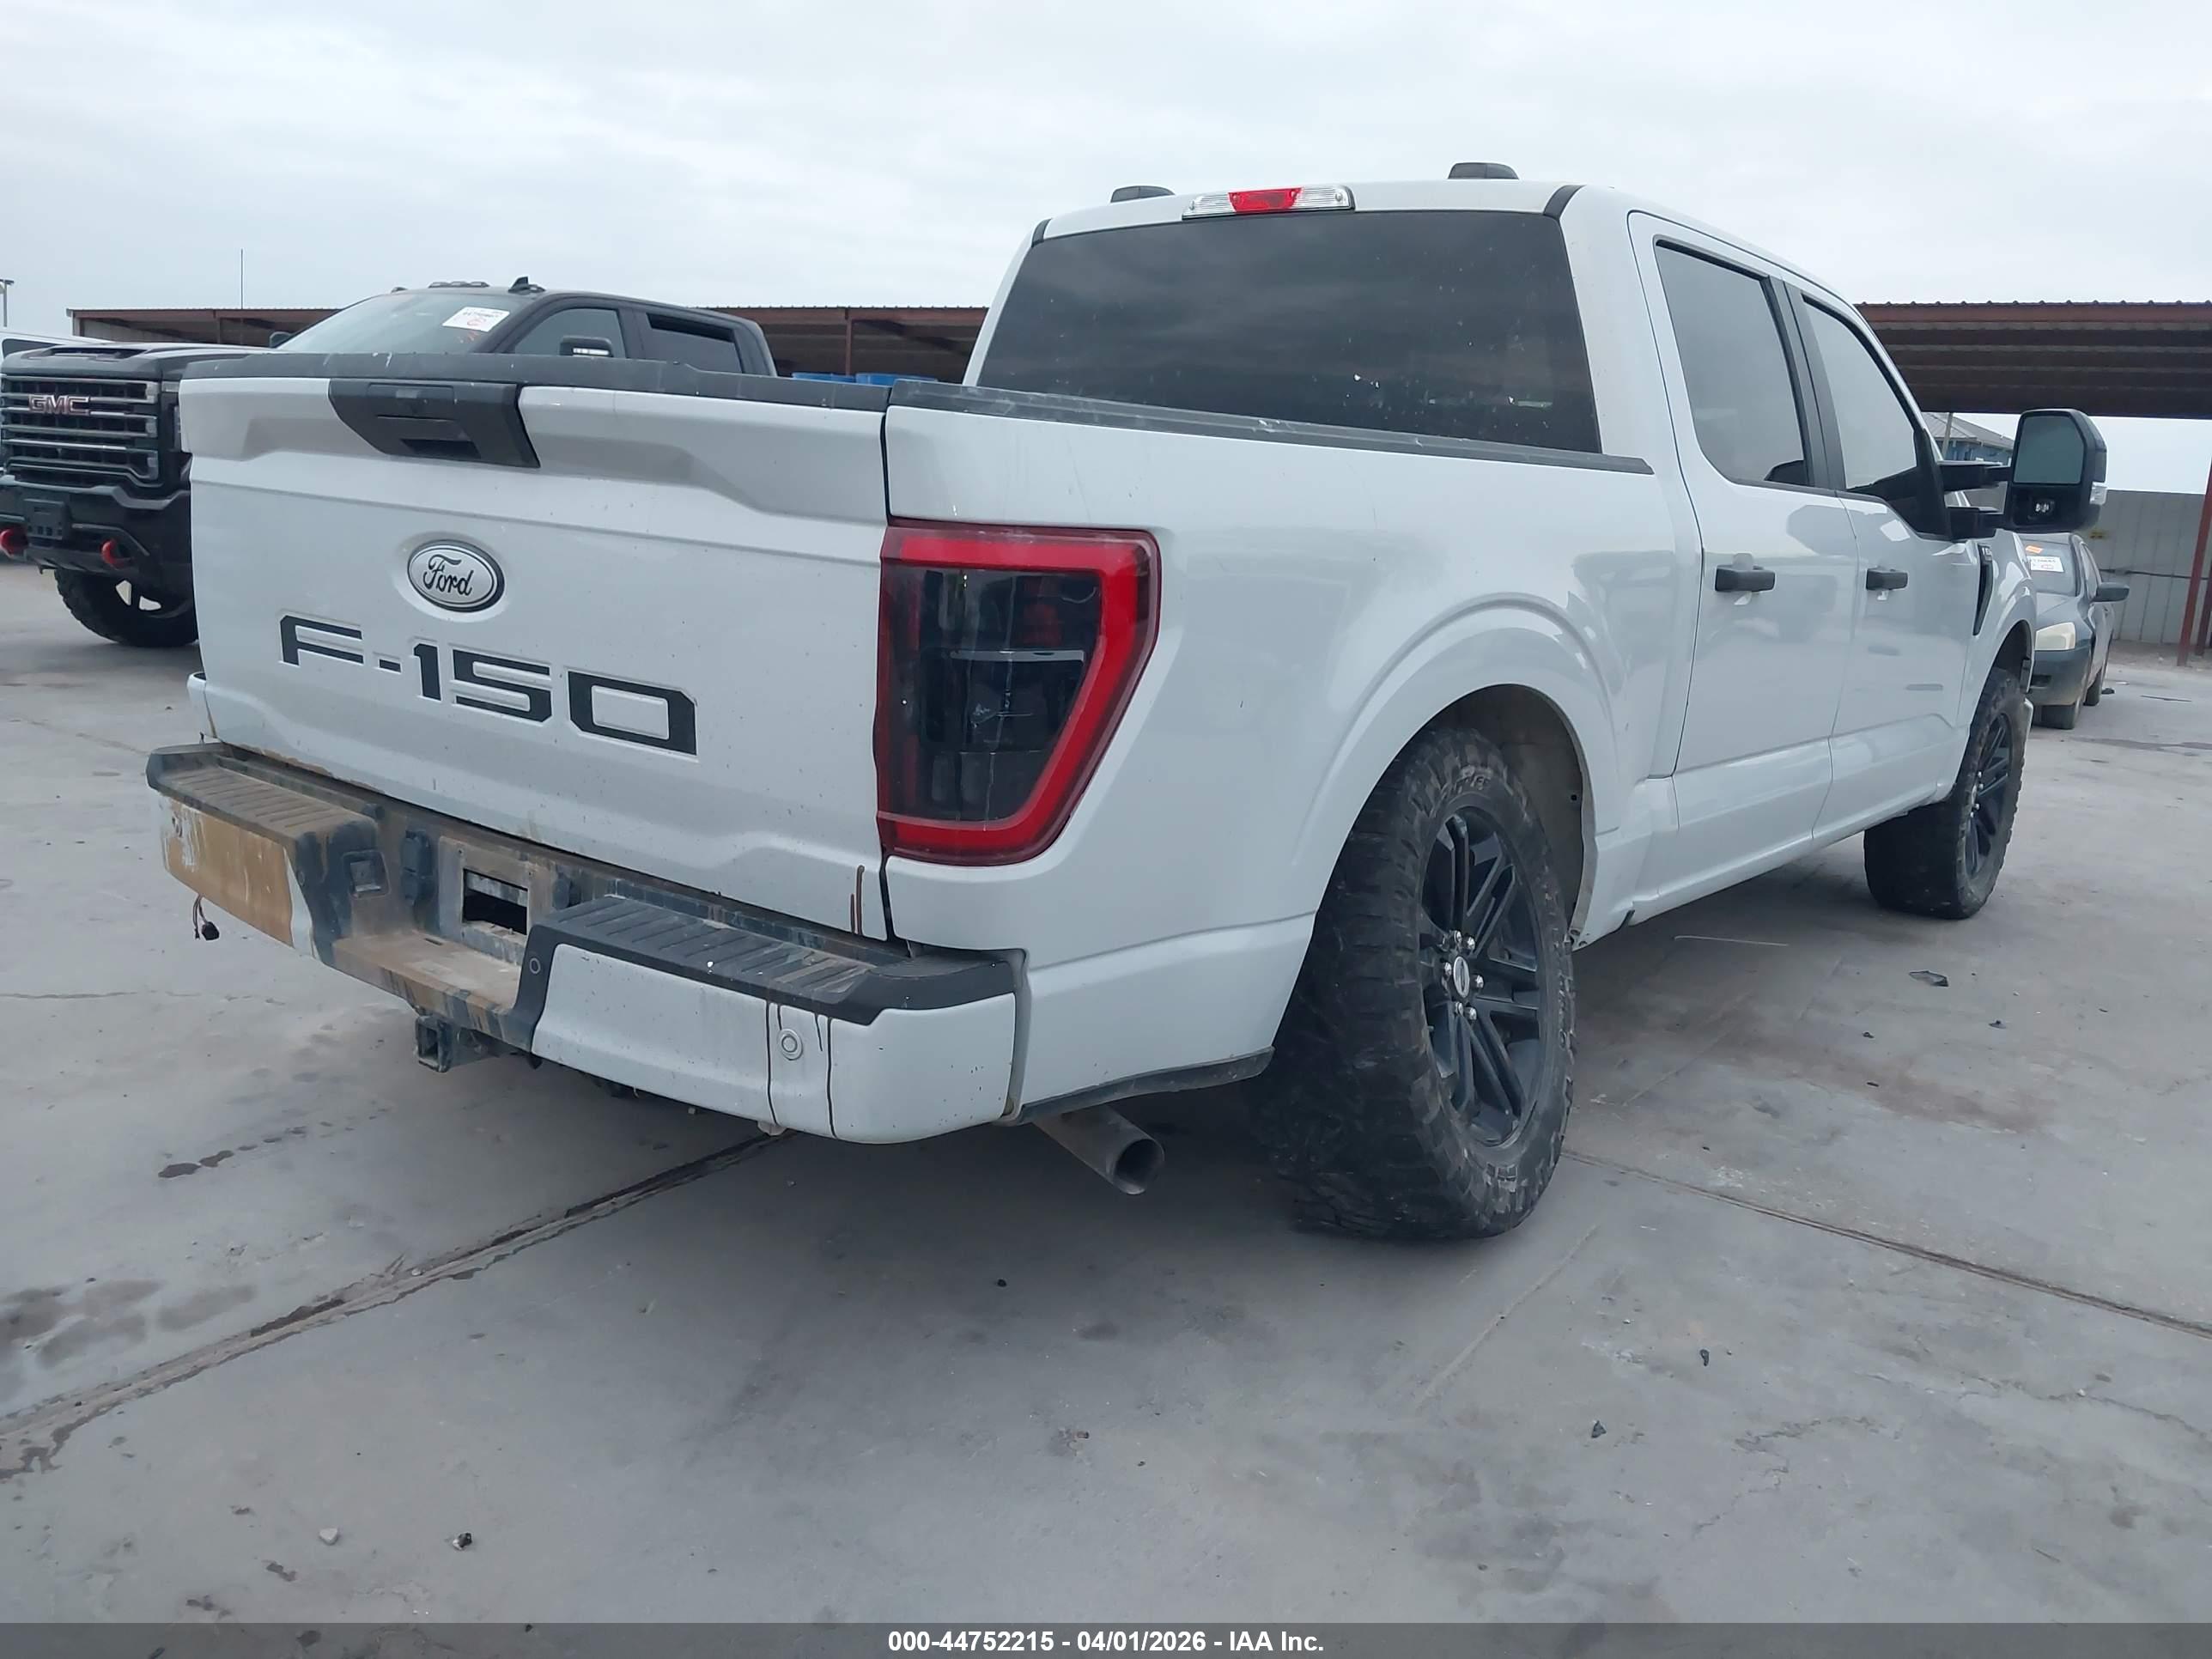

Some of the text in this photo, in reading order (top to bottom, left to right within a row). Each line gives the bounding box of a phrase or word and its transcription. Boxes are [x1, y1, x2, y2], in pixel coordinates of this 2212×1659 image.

[28, 394, 90, 416] GMC
[423, 554, 474, 596] Ford
[280, 614, 698, 757] F-150
